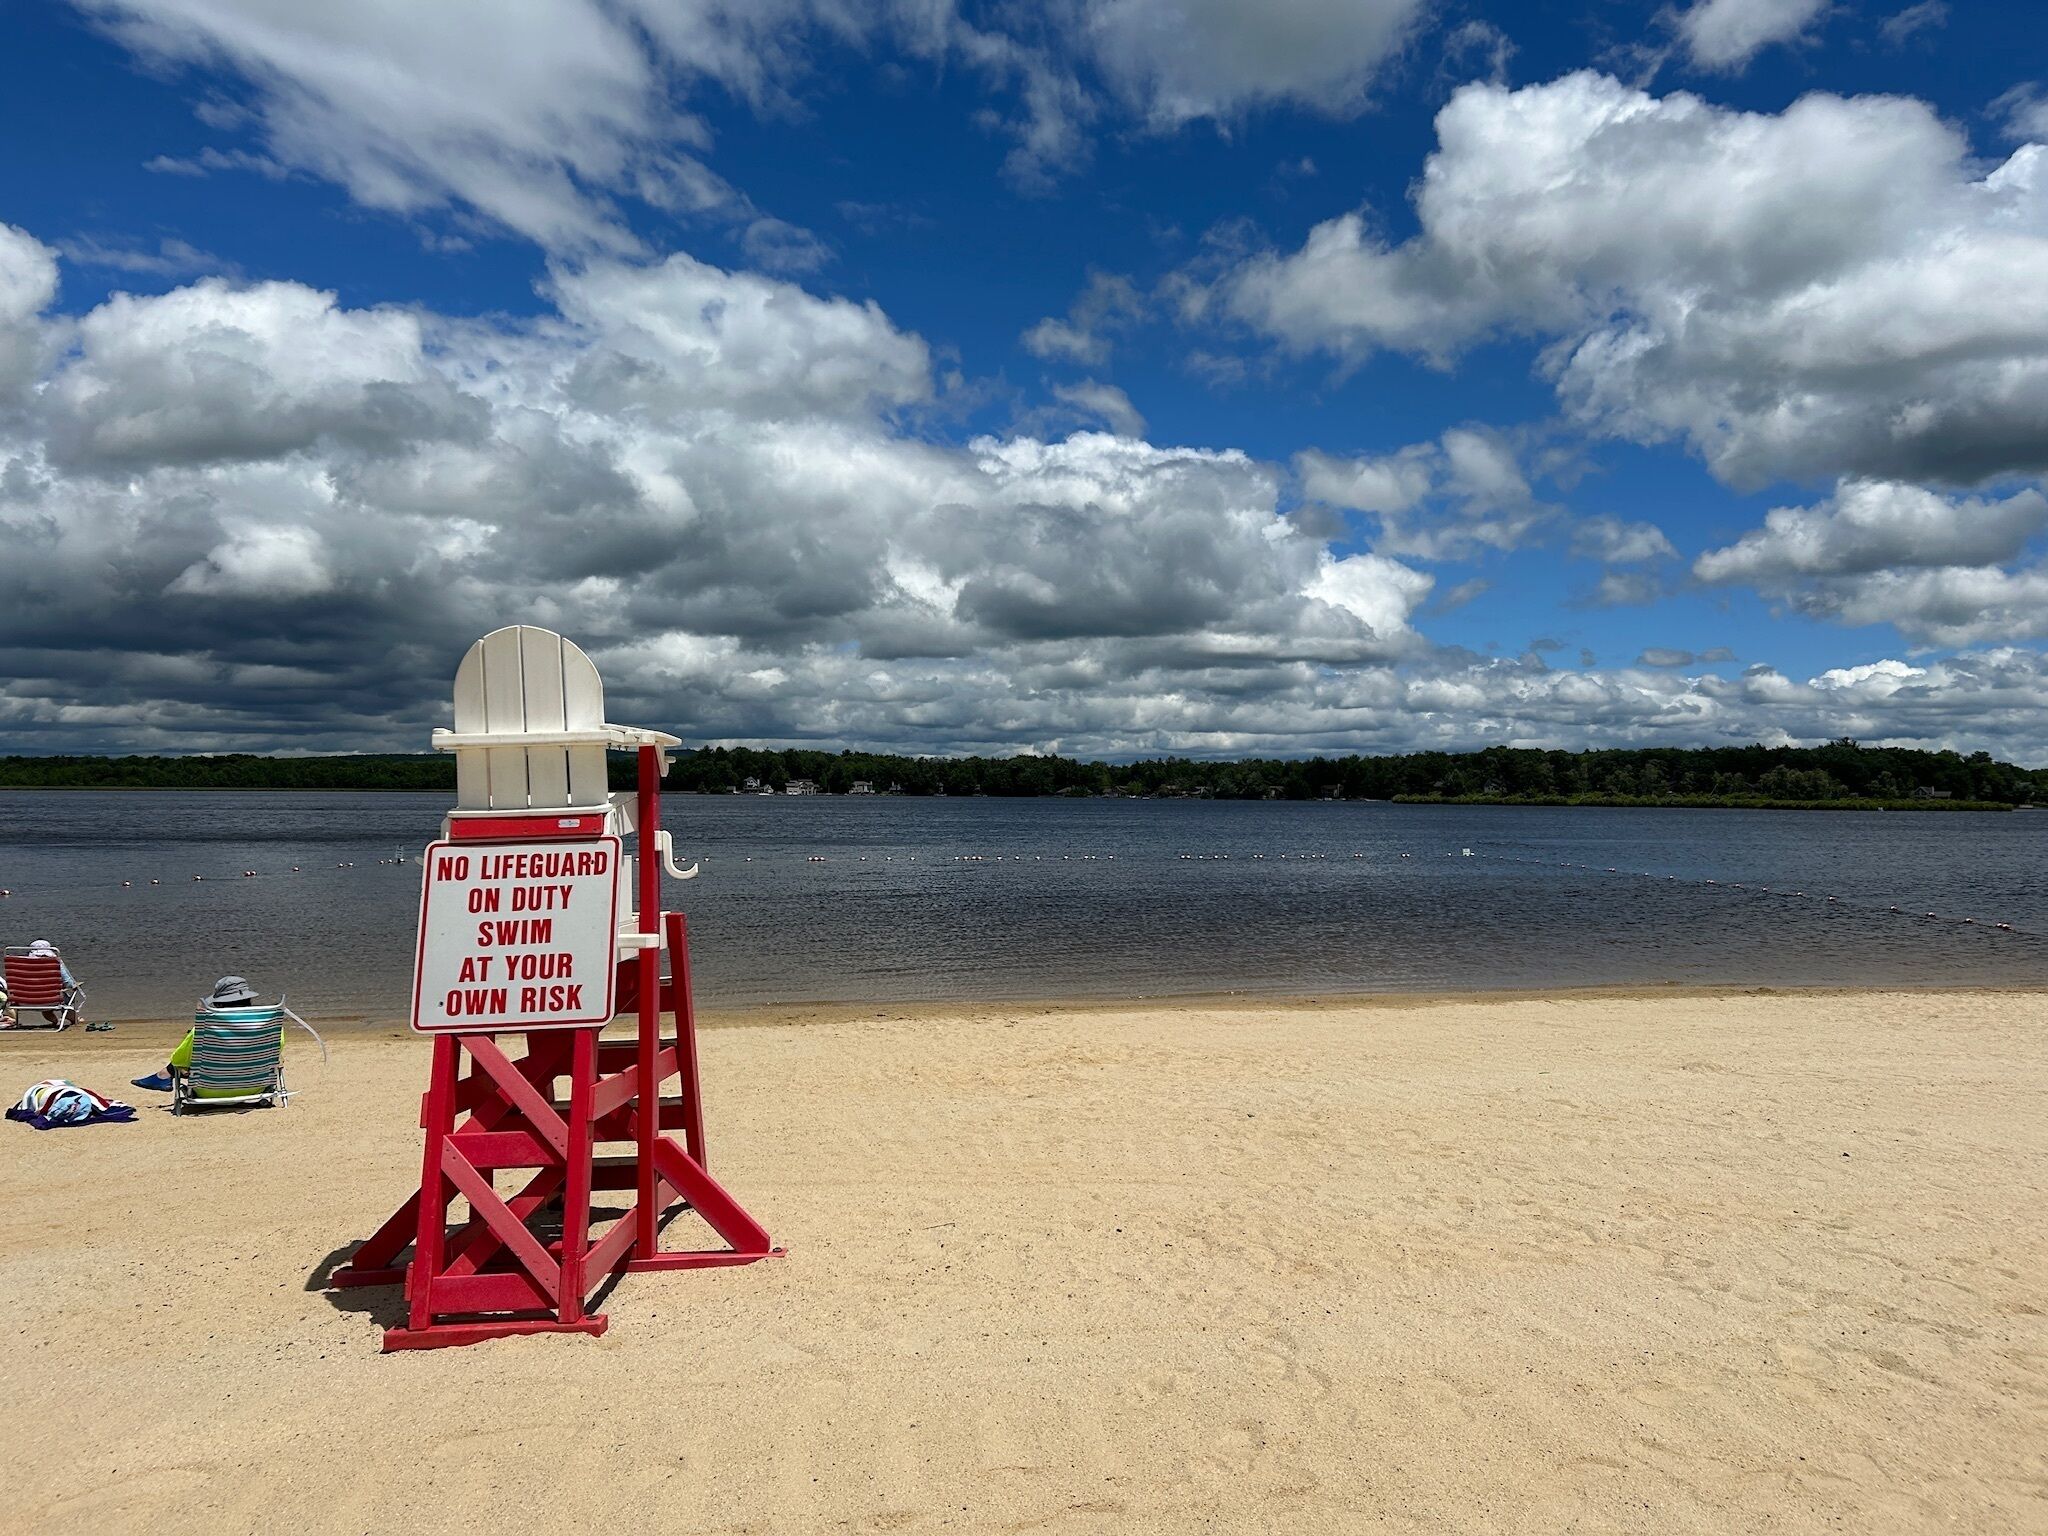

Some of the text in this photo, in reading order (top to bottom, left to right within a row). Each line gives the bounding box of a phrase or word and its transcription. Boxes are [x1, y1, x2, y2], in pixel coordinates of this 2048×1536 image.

[437, 851, 608, 881] NO LIFEGUARD
[468, 884, 573, 914] ON DUTY
[477, 918, 552, 947] SWIM
[458, 953, 573, 983] AT YOUR
[446, 984, 583, 1017] OWN RISK
